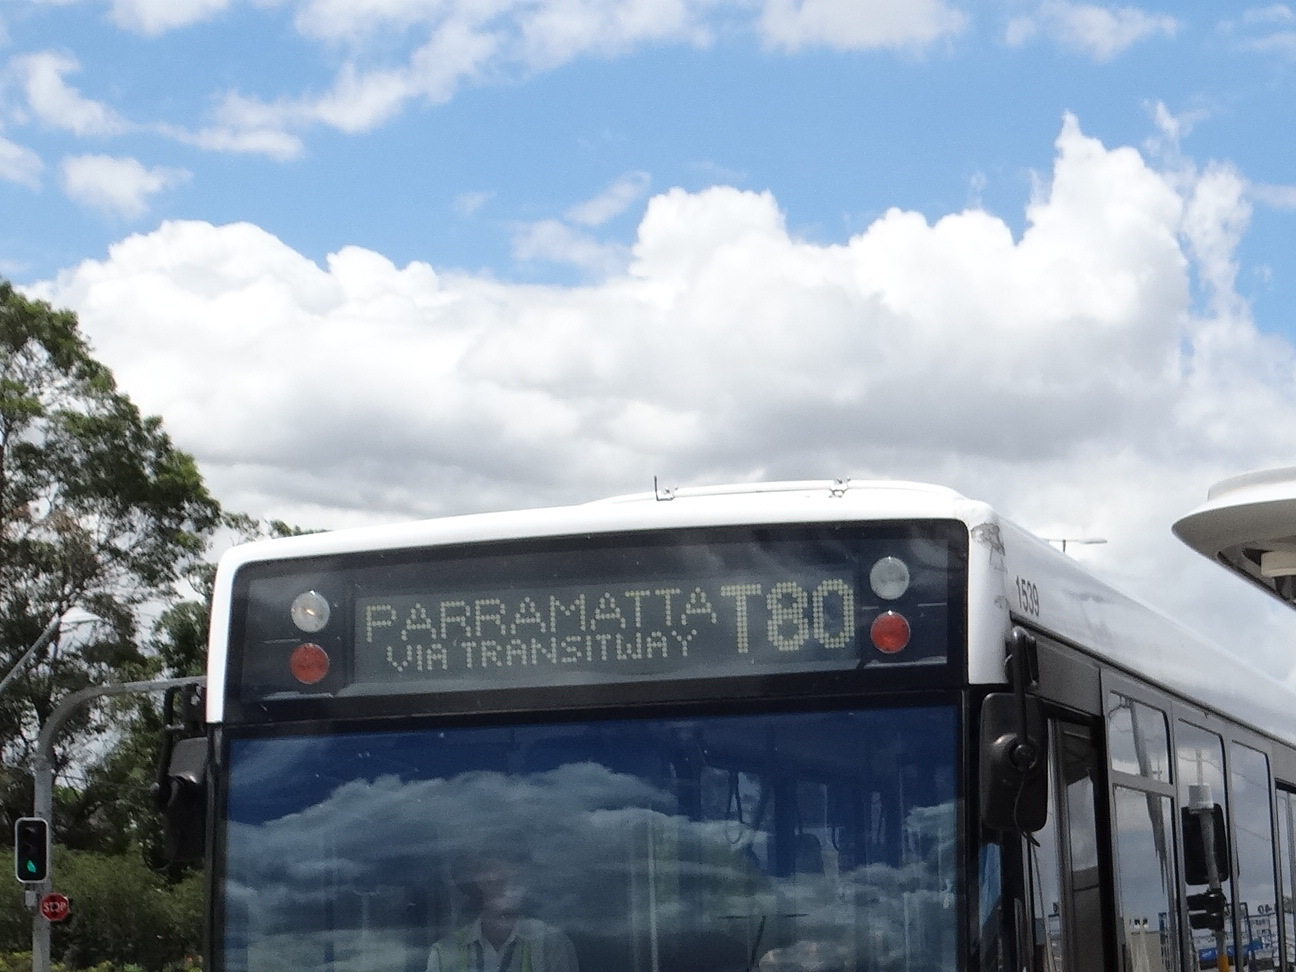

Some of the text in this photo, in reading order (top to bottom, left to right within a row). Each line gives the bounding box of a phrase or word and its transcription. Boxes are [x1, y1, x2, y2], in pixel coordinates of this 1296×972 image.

[365, 587, 718, 643] PARRAMATTA
[720, 578, 855, 654] T80
[1015, 574, 1040, 617] 1539
[387, 629, 698, 672] VIA TRANSITWAY
[43, 901, 67, 912] STOP
